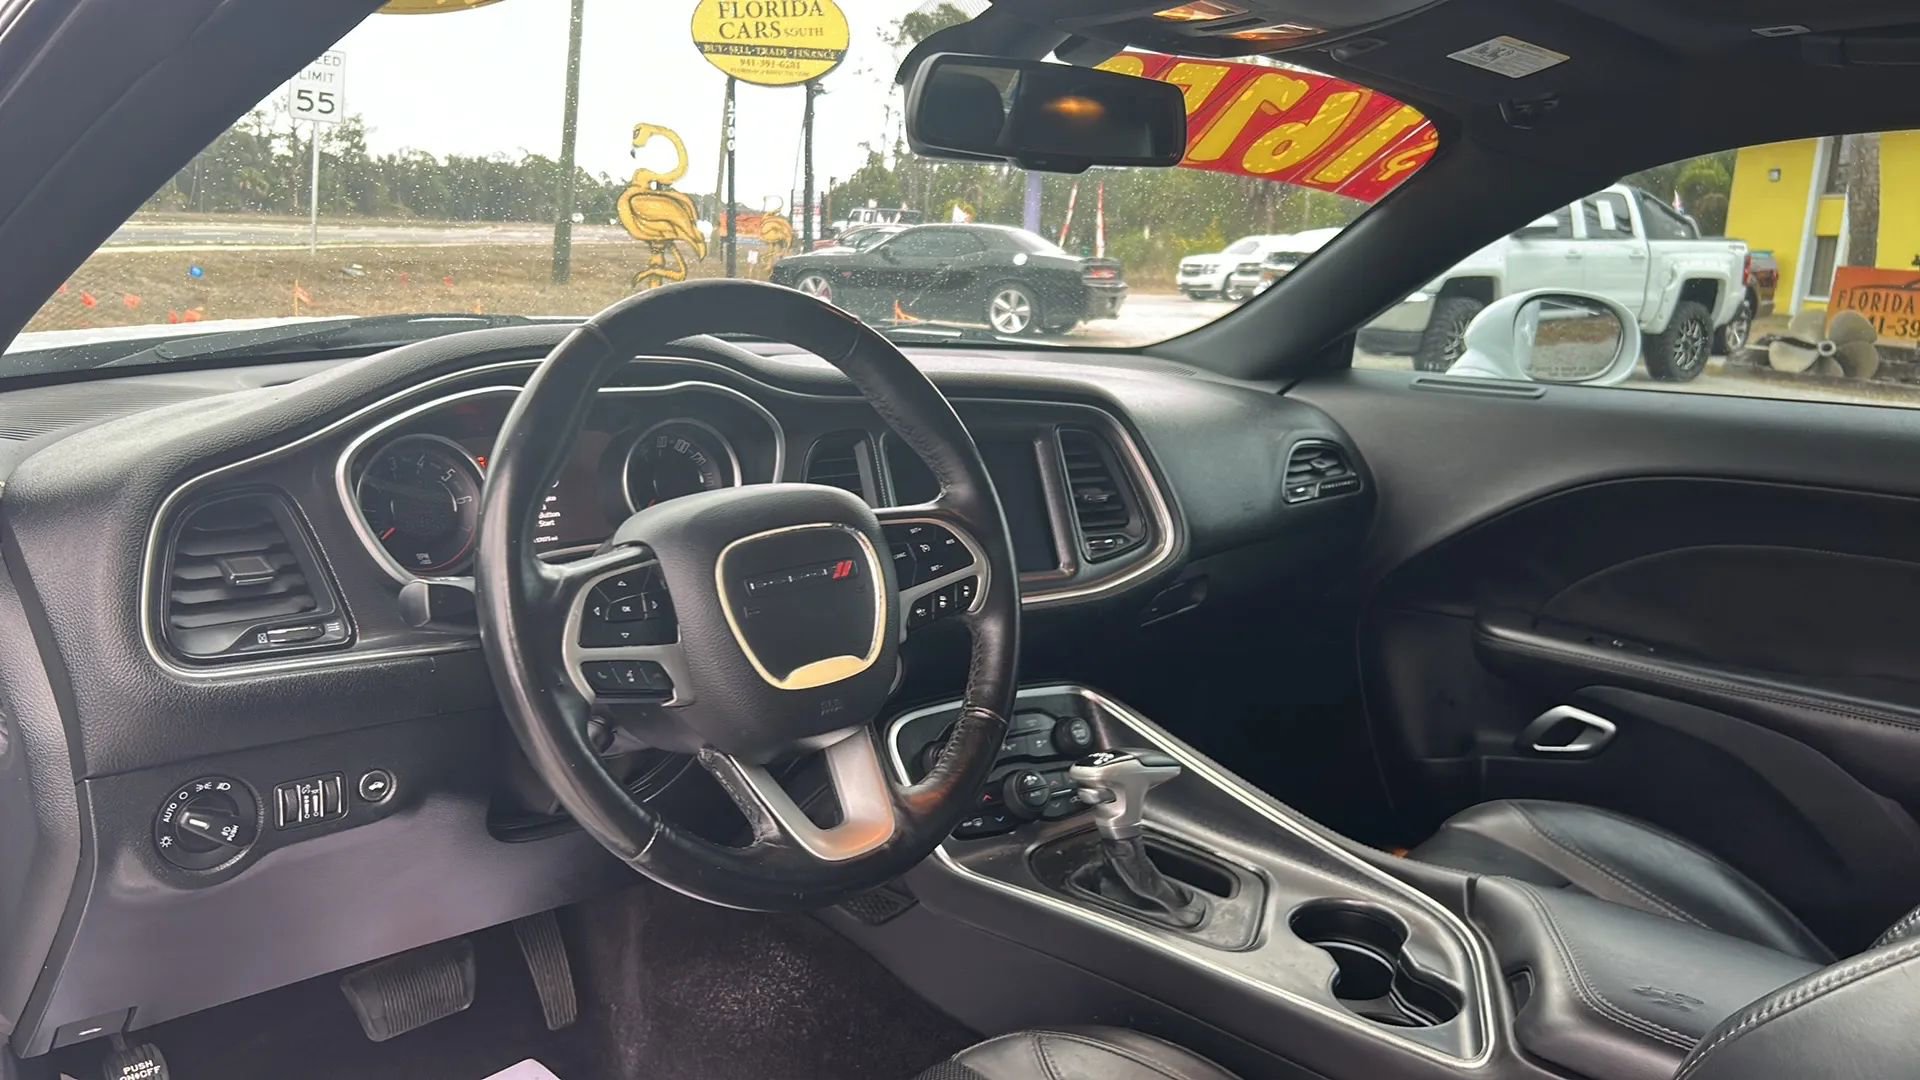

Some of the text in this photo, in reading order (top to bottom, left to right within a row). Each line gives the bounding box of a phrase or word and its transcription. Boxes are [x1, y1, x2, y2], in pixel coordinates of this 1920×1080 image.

[718, 0, 824, 18] FLORIDA
[719, 20, 824, 39] CARS SOUTH
[299, 70, 335, 83] LIMIT
[297, 89, 335, 114] 55
[1837, 289, 1915, 314] FLORIDA
[440, 468, 456, 482] 5
[456, 495, 473, 505] 6
[621, 605, 632, 613] OK
[163, 802, 177, 823] AUTO
[226, 825, 239, 842] PUSH
[122, 1059, 154, 1075] PUSH
